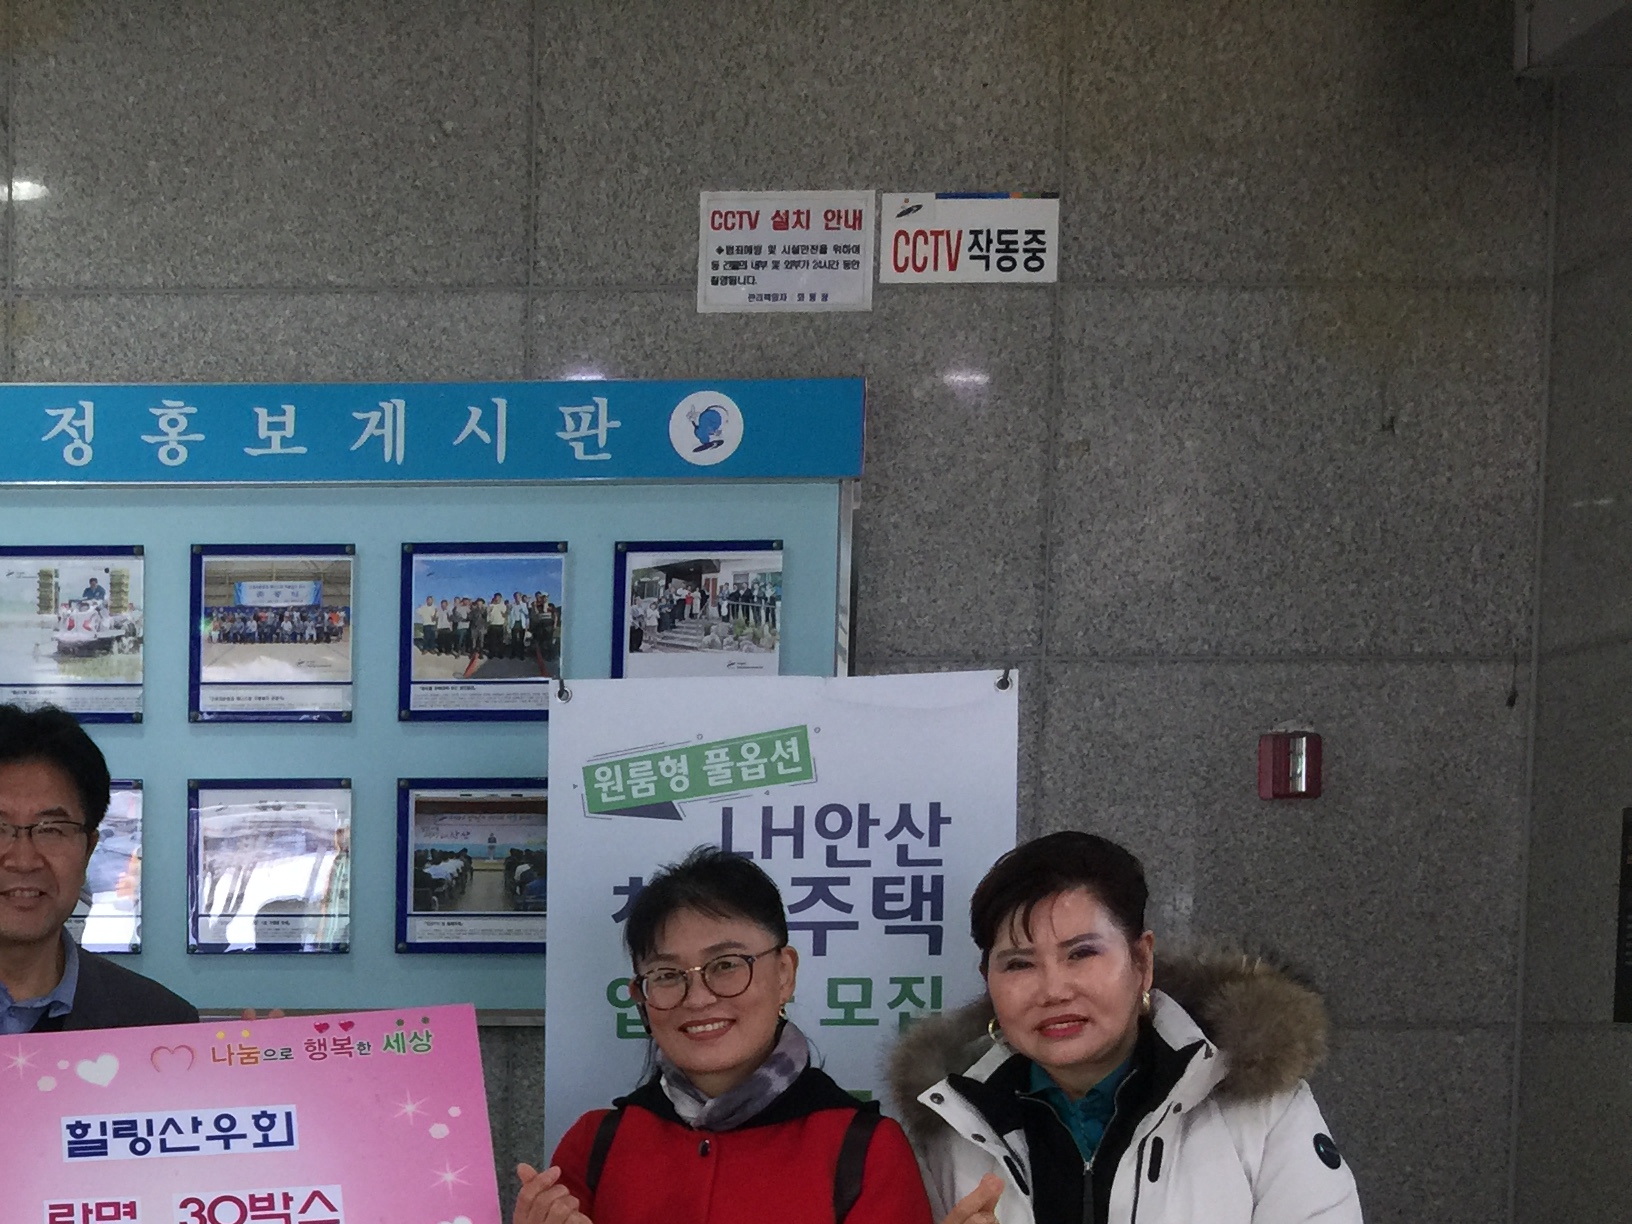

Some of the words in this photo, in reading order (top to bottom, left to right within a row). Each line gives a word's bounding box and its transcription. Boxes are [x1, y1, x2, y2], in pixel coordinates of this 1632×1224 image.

[710, 210, 760, 231] CCTV
[770, 208, 811, 231] 설치
[823, 208, 863, 231] 안내
[893, 229, 963, 273] CCTV
[967, 228, 1047, 273] 작동중
[591, 752, 692, 805] 원룸형
[699, 733, 806, 789] 풀옵션
[719, 801, 954, 869] LH안산
[210, 1041, 296, 1068] 나눔으로
[303, 1034, 372, 1060] 행복한
[382, 1028, 434, 1054] 세상
[65, 1110, 295, 1159] 힐링산우회
